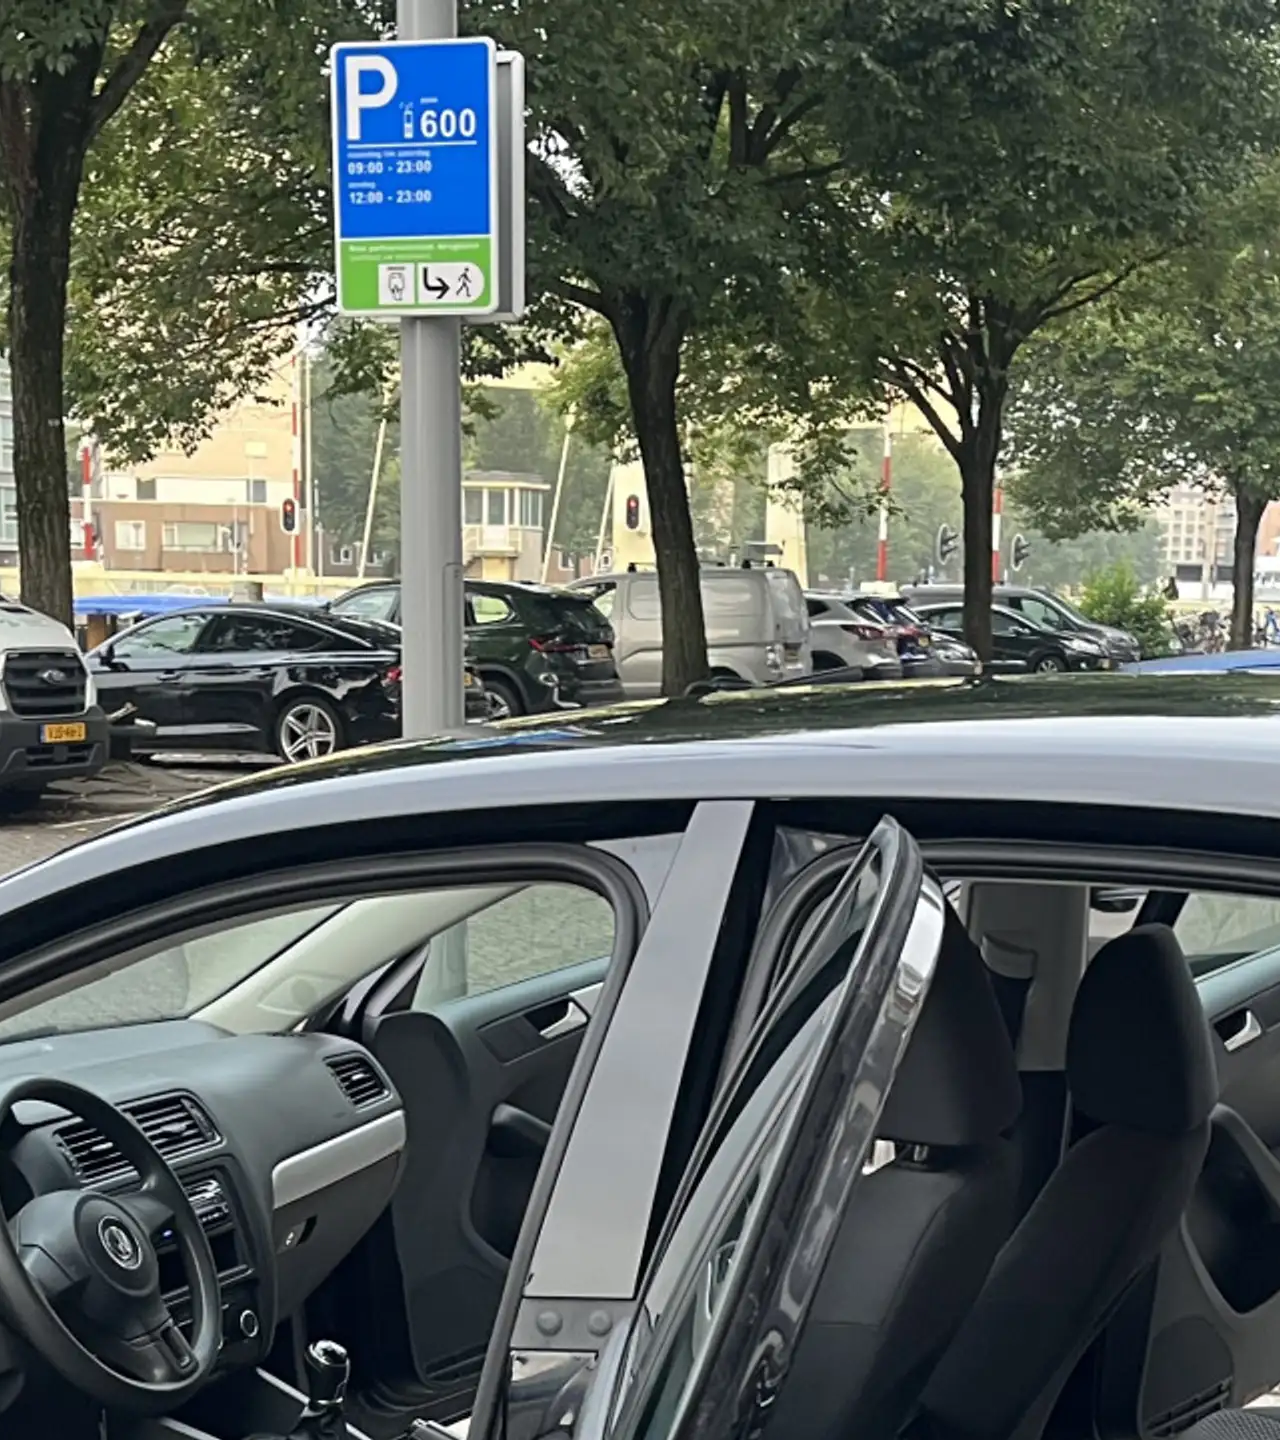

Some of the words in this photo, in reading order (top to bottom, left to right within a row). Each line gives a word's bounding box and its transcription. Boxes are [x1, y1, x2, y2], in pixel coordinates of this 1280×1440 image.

[345, 55, 398, 141] P
[420, 108, 476, 138] 600
[348, 161, 383, 174] 09:00
[396, 160, 432, 173] 23:00
[349, 191, 383, 204] 12:00
[396, 189, 432, 203] 23:00
